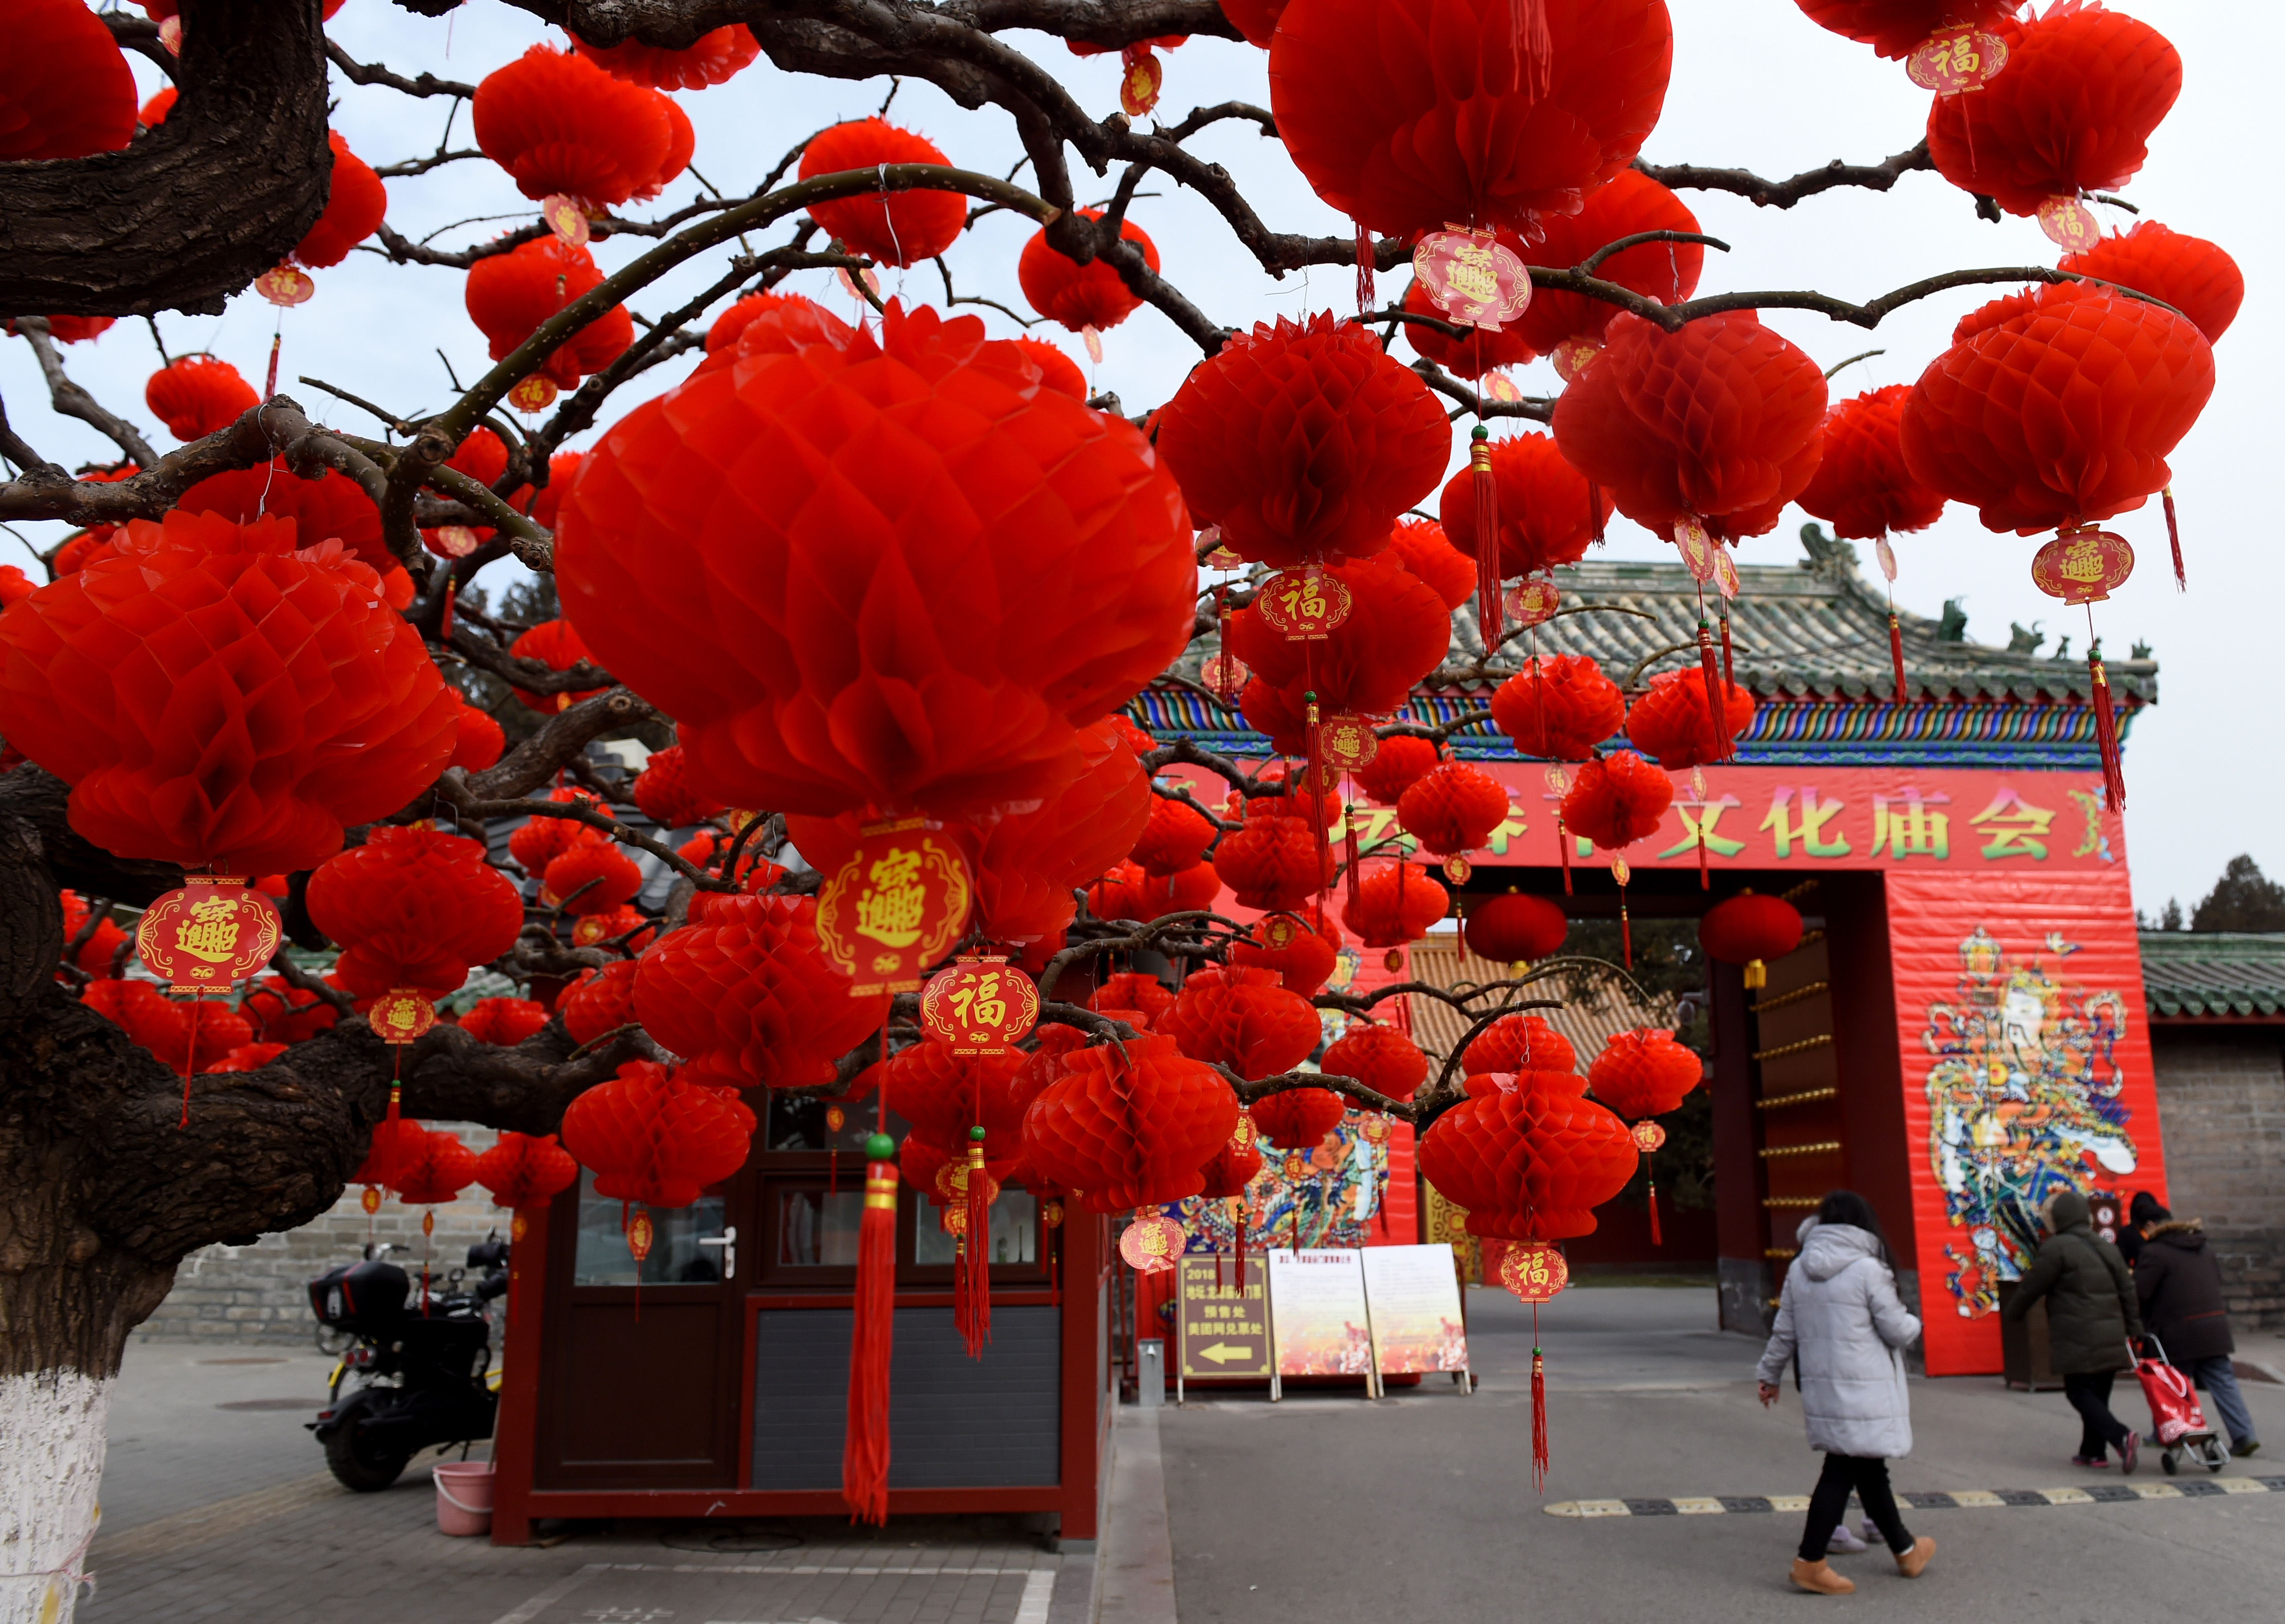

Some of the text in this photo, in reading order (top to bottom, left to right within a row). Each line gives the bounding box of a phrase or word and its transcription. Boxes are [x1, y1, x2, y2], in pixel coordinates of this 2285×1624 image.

[1929, 35, 1980, 77] 福
[2052, 205, 2085, 239] 福
[268, 269, 298, 296] 福
[518, 382, 544, 403] 福
[1279, 576, 1326, 621] 福
[1551, 771, 1565, 789] 福
[948, 971, 1006, 1027] 福
[1639, 1126, 1655, 1144] 福
[1187, 1269, 1216, 1280] 2018
[1515, 1251, 1549, 1285] 福
